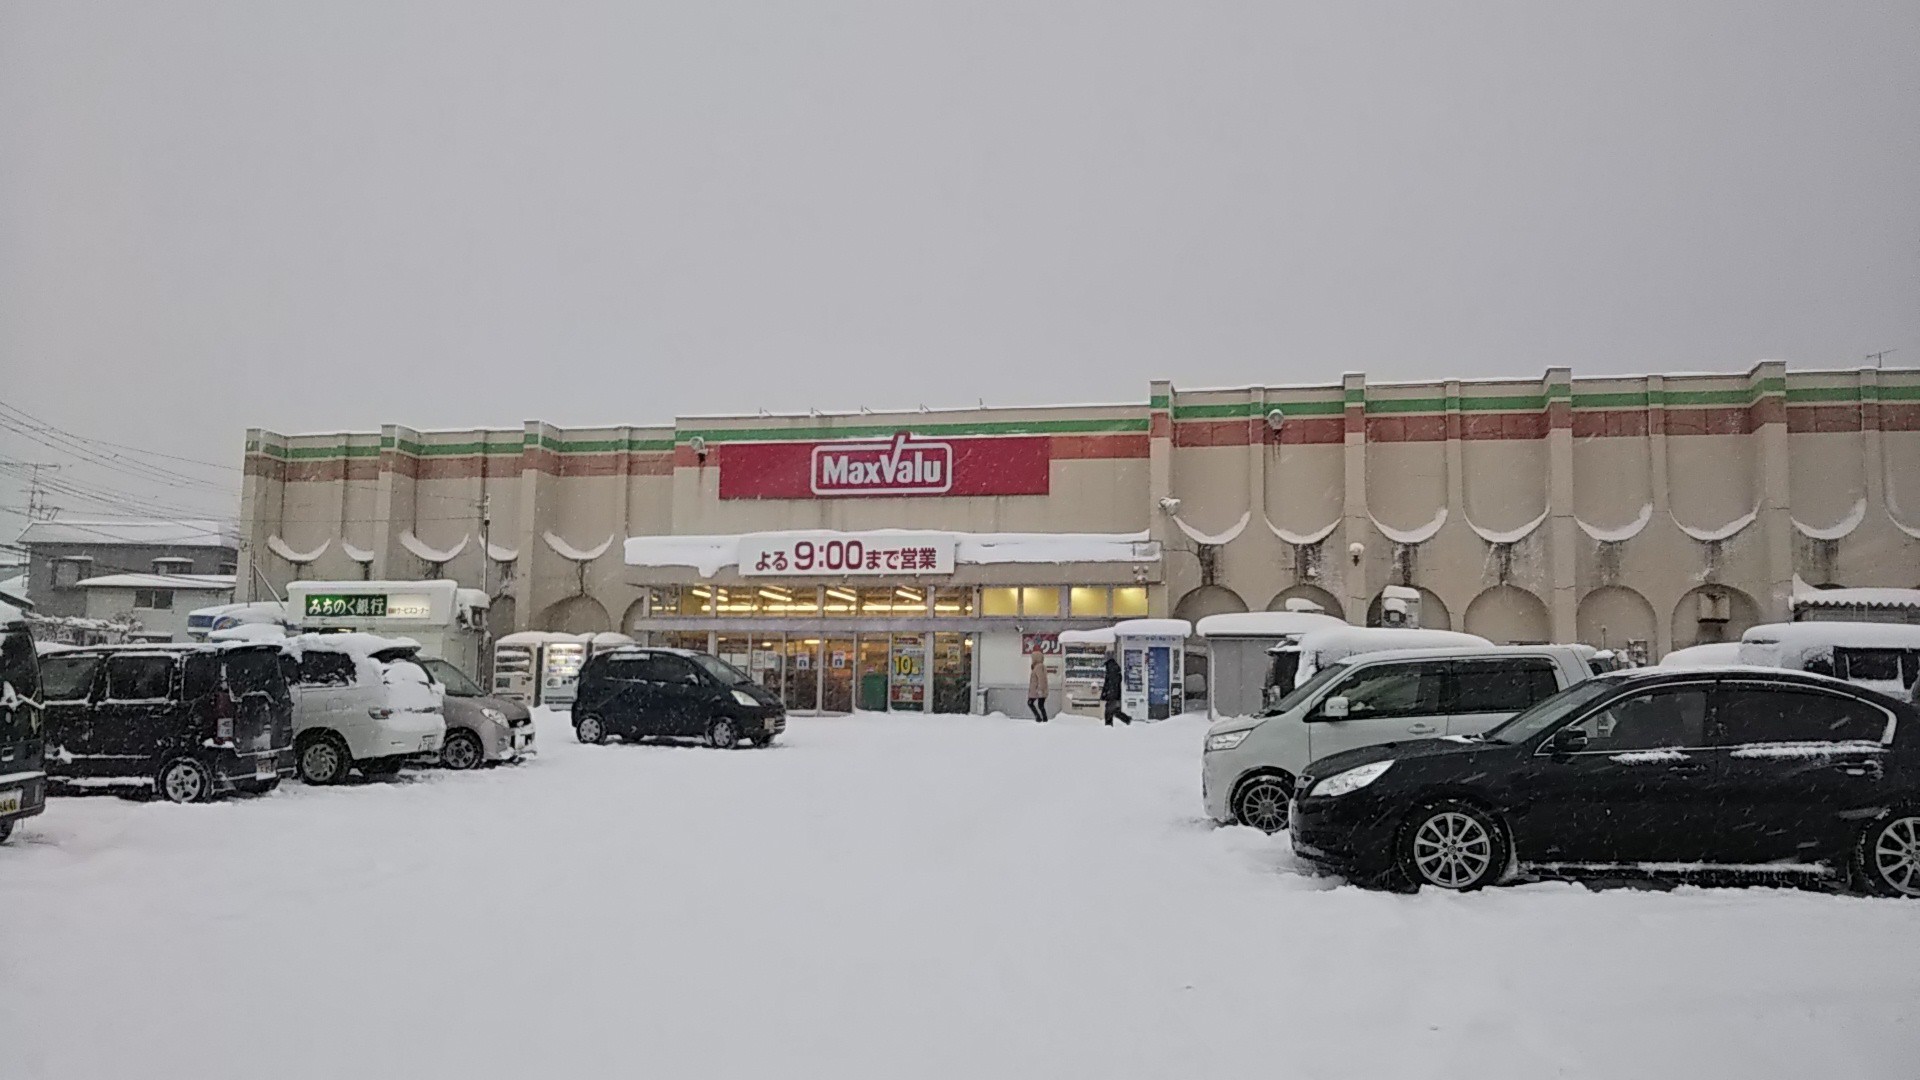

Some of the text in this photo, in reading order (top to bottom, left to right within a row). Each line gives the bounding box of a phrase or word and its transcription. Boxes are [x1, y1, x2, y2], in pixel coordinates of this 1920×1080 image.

[822, 435, 942, 484] MaxValu
[755, 540, 937, 571] よる9:00まで営業
[308, 598, 385, 615] みちのく銀行
